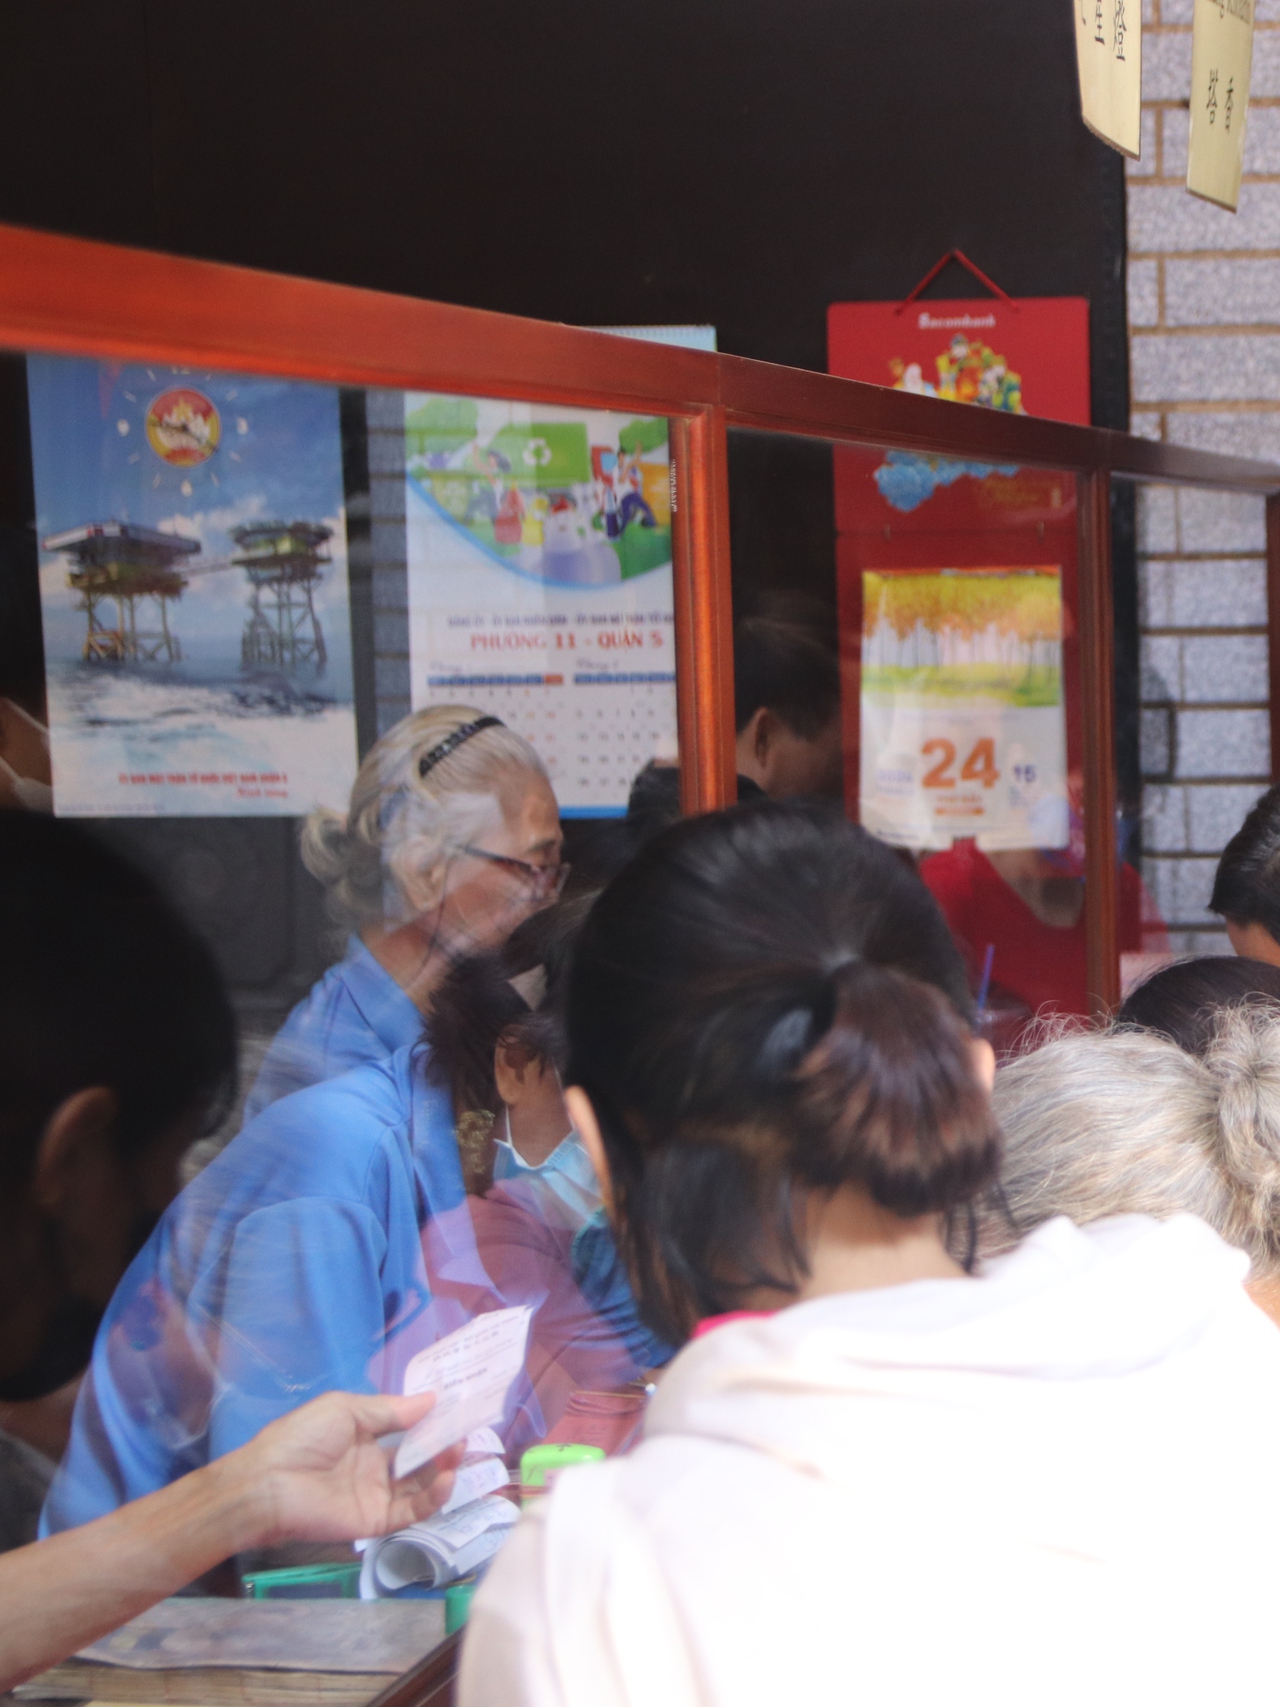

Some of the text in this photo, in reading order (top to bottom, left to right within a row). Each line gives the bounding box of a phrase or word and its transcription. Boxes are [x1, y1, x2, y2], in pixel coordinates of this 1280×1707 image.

[556, 632, 576, 649] 11
[650, 630, 663, 648] 5
[921, 738, 1000, 789] 24
